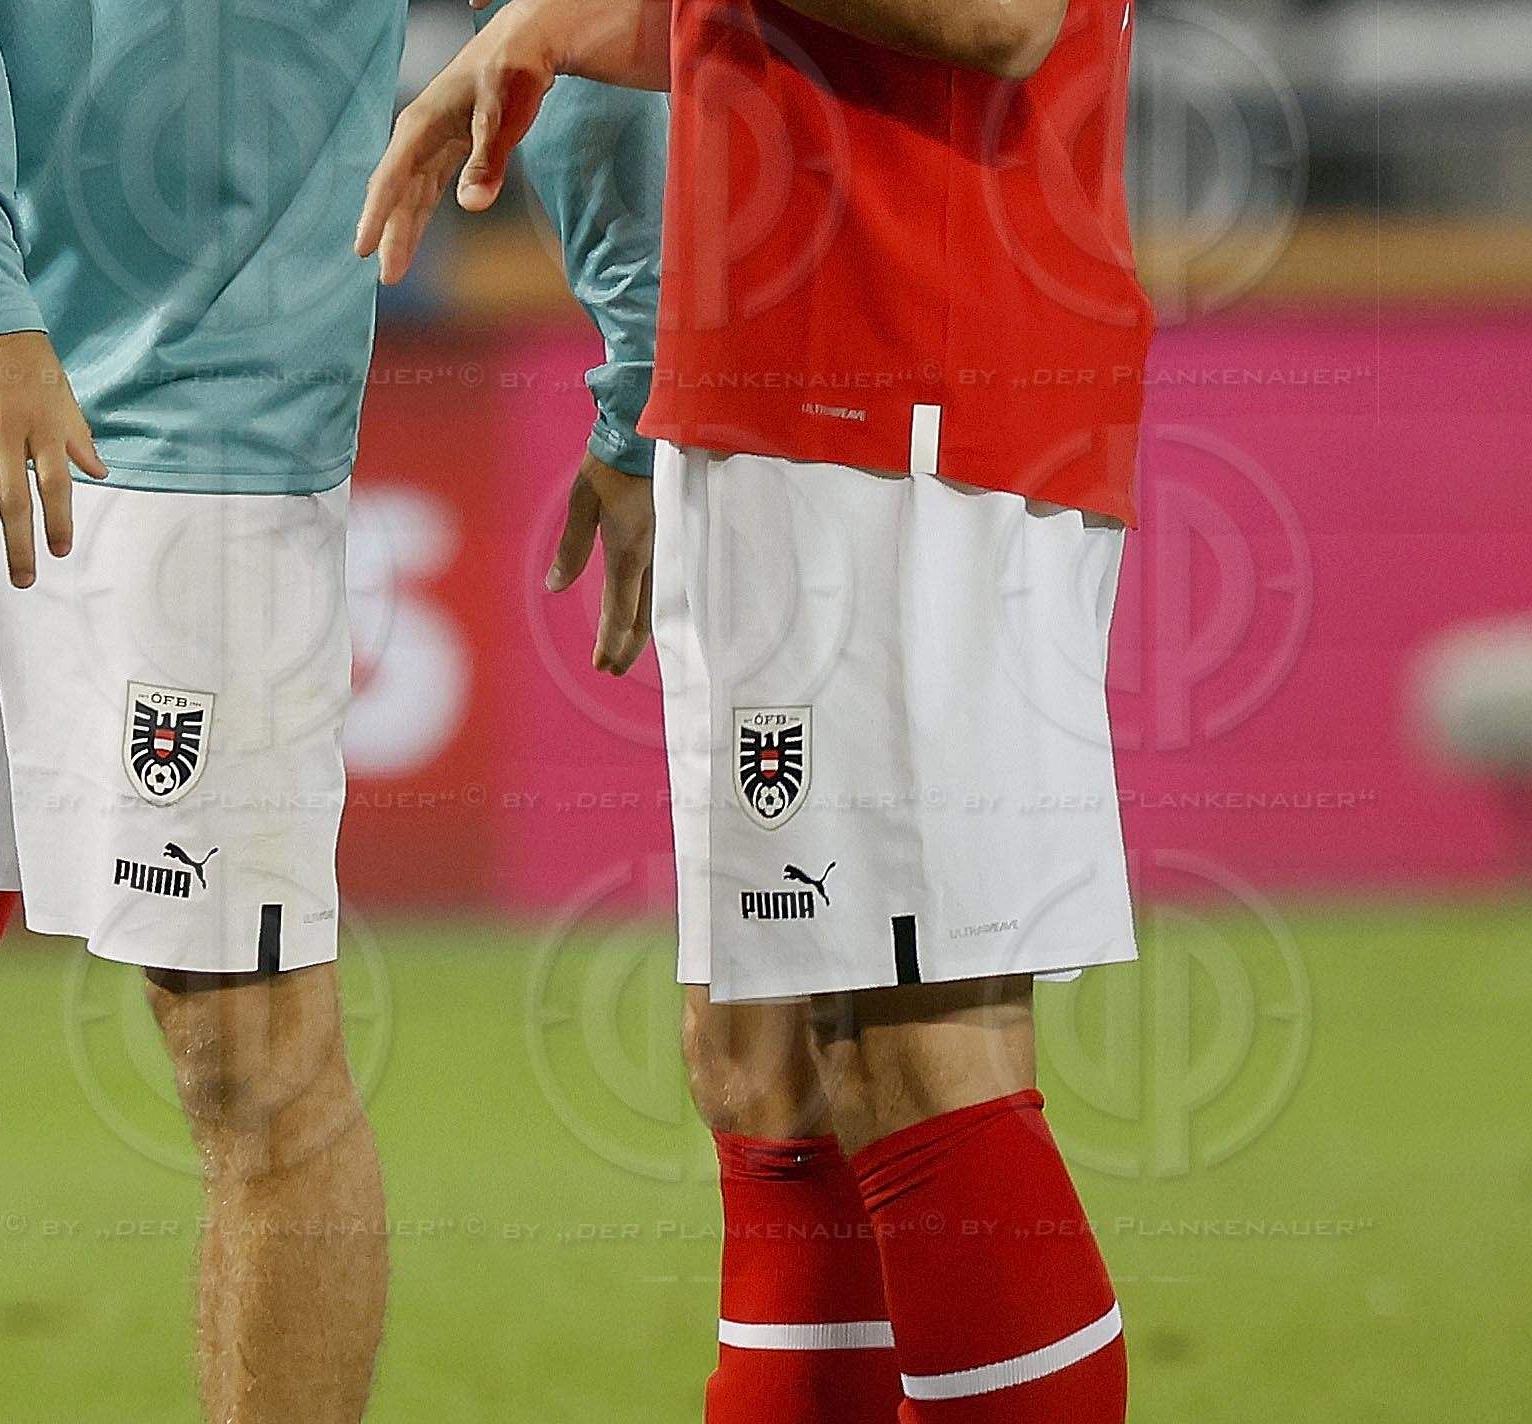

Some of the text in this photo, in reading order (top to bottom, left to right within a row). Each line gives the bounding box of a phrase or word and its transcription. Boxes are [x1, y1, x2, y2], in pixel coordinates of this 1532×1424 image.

[150, 692, 188, 708] ÖFB
[114, 858, 192, 898] PUMA
[740, 891, 815, 919] PUMA
